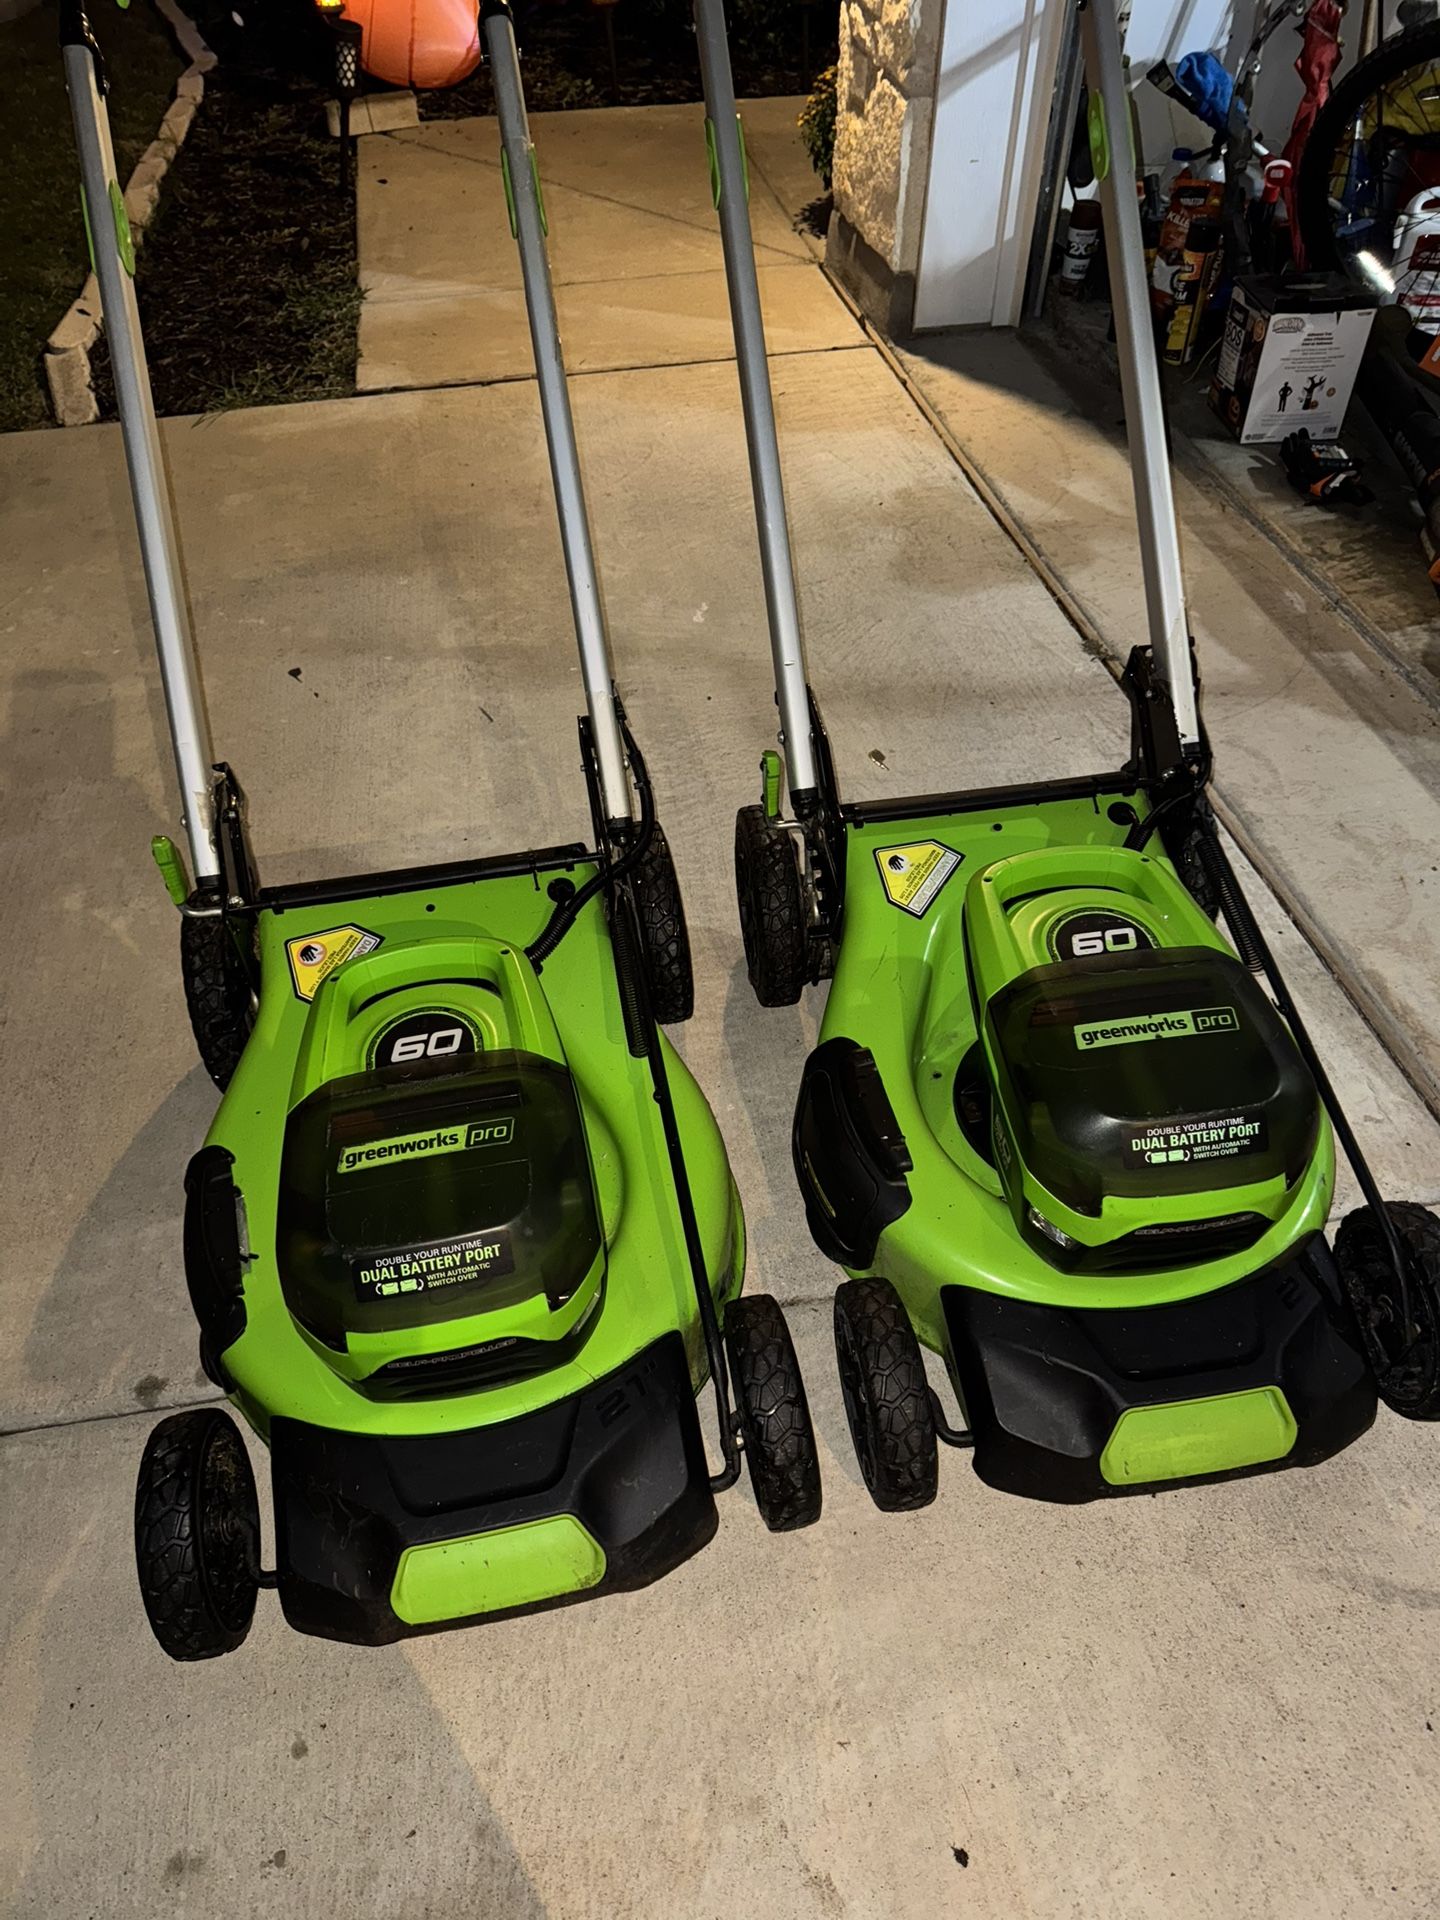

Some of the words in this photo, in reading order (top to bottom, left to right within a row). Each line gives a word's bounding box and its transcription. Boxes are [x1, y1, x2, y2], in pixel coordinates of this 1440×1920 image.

[1069, 242, 1087, 255] 2X
[1071, 927, 1138, 957] 60
[1081, 1017, 1188, 1046] greenworks
[1196, 1013, 1233, 1031] pro
[390, 1027, 464, 1064] 60
[1131, 1137, 1168, 1151] DUAL
[1169, 1128, 1226, 1147] BATTERY
[1228, 1122, 1260, 1139] PORT
[1146, 1125, 1181, 1137] DOUBLE
[1182, 1120, 1207, 1132] YOUR
[1207, 1116, 1245, 1129] RUNTIME
[344, 1132, 460, 1169] greenworks
[470, 1124, 508, 1146] pro
[1192, 1145, 1210, 1153] WITH
[1211, 1139, 1251, 1151] AUTOMATIC
[1193, 1150, 1220, 1160] SWITCH
[1220, 1147, 1239, 1156] OVER
[360, 1266, 398, 1284] DUAL
[400, 1252, 462, 1277] BATTERY
[465, 1244, 501, 1264] PORT
[375, 1253, 412, 1268] DOUBLE
[413, 1247, 440, 1262] YOUR
[441, 1239, 483, 1254] RUNTIME
[426, 1272, 446, 1282] WITH
[447, 1262, 491, 1278] AUTOMATIC
[427, 1277, 457, 1289] SWITCH
[457, 1271, 478, 1283] OVER
